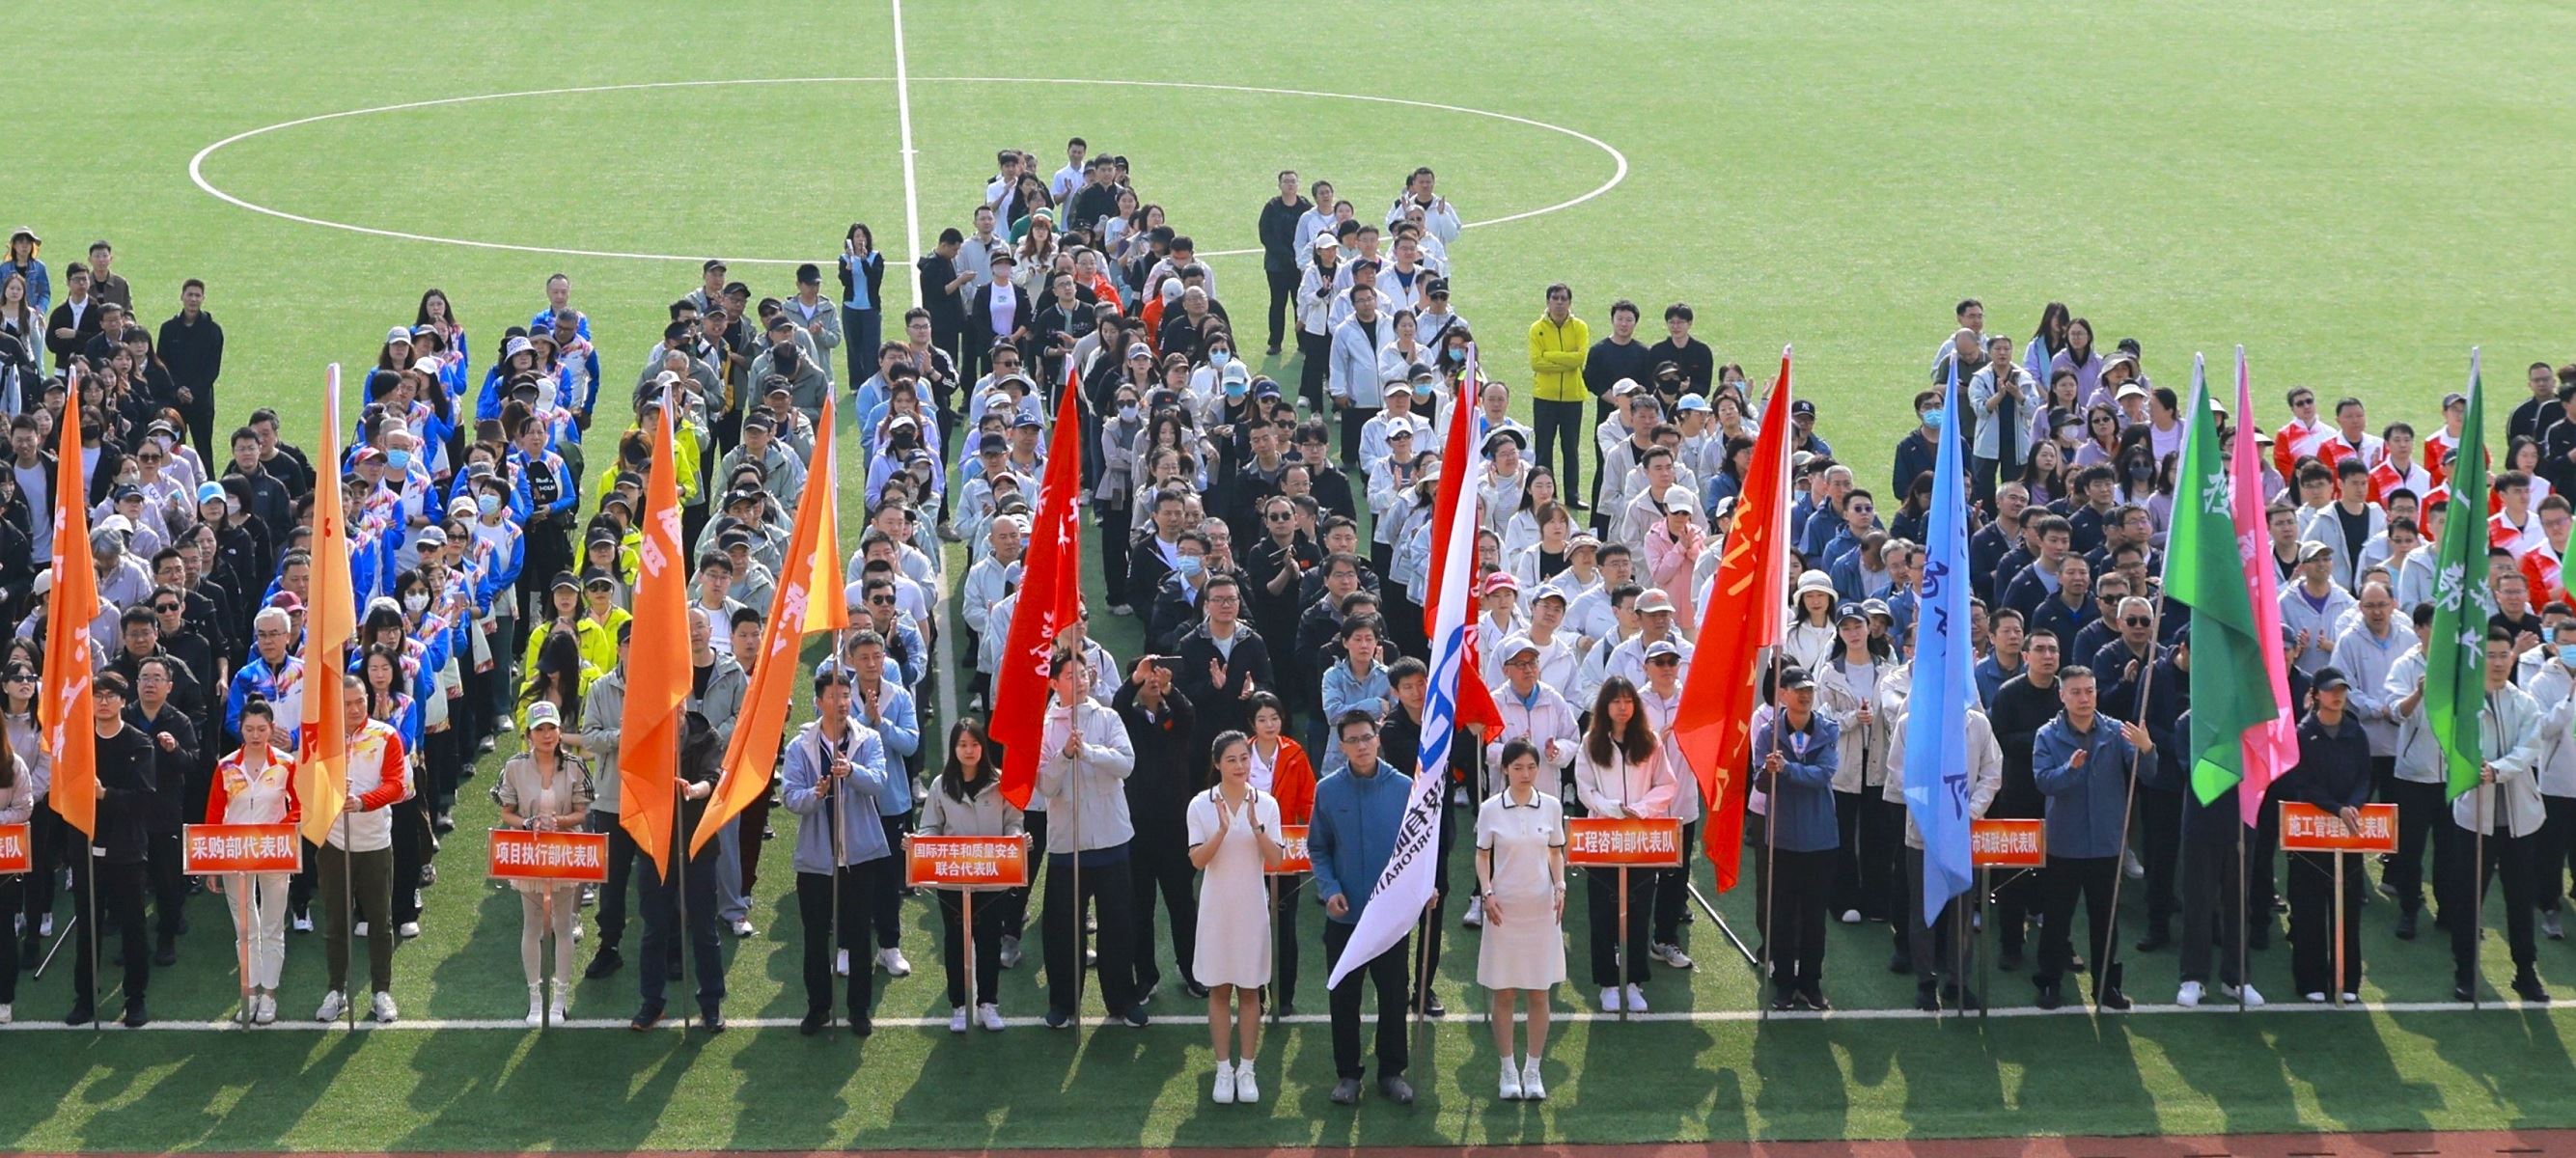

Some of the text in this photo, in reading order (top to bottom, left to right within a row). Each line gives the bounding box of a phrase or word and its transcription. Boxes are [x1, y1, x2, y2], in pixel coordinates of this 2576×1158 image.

[191, 835, 294, 860] 采购部代表队
[913, 842, 1019, 858] 国际开车和质量安全
[1571, 830, 1676, 854] 工程咨询部代表队
[1972, 831, 2038, 854] 市场联合代表队
[495, 841, 600, 868] 项目执行部代表队
[934, 861, 999, 877] 联合代表队
